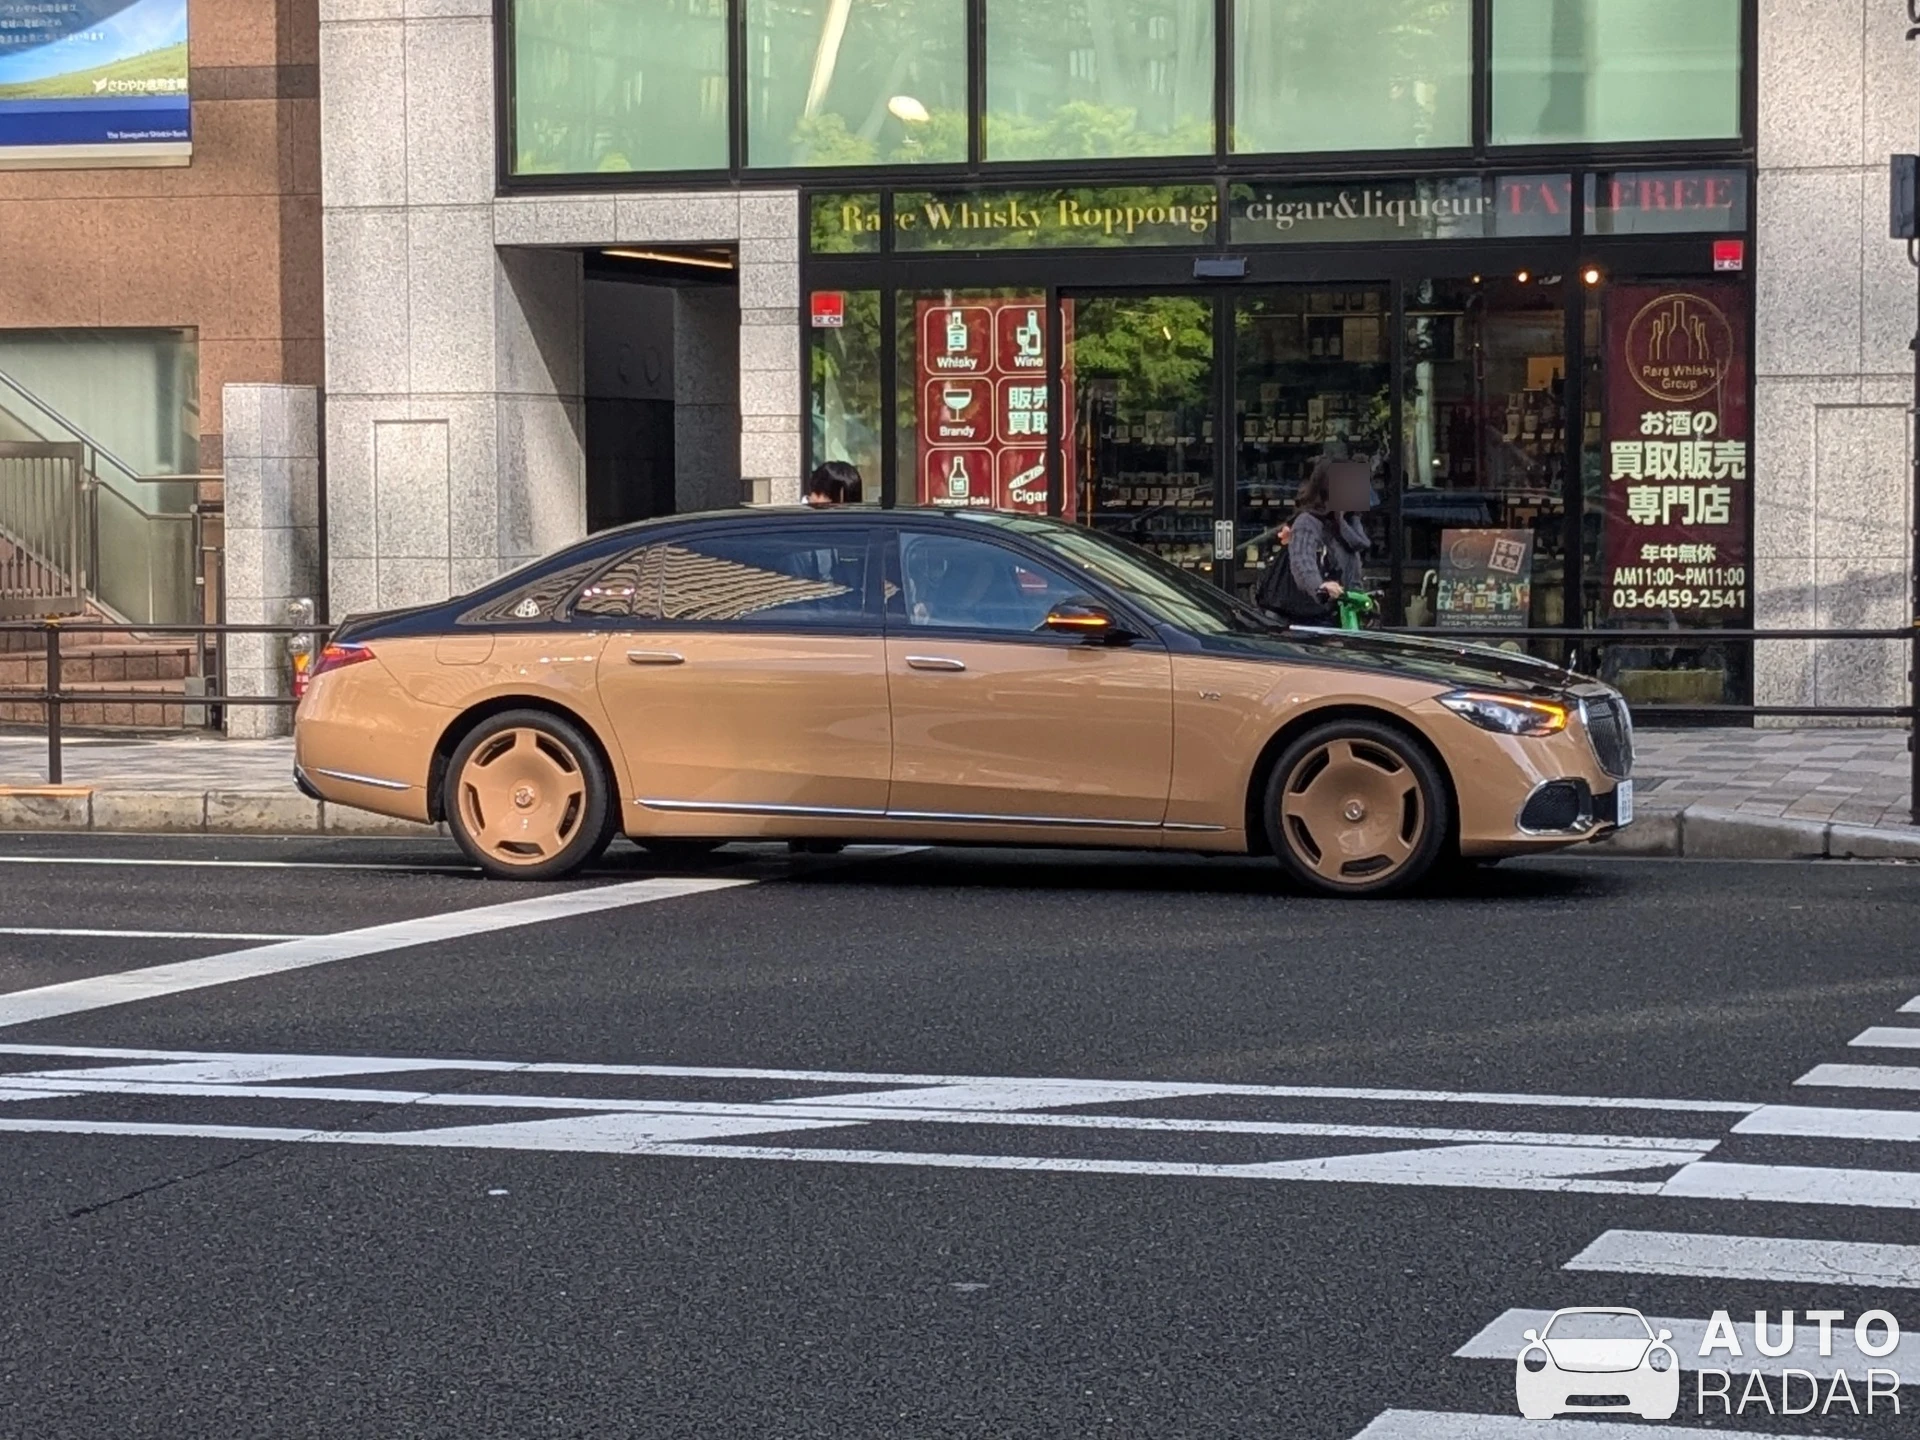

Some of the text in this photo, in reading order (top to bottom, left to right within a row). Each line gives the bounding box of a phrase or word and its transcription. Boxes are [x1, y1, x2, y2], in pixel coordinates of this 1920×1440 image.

[1502, 177, 1733, 216] TA FREE
[924, 200, 1046, 235] Whisky
[1059, 196, 1217, 235] Roppongi
[1246, 188, 1493, 231] cigar&liqueur
[937, 356, 978, 370] Whisky
[1014, 356, 1044, 367] Wine
[1643, 364, 1716, 378] Rare Whisky
[1662, 378, 1698, 391] Group
[939, 425, 976, 437] Brandy
[1640, 411, 1718, 436] お酒の
[1609, 440, 1747, 480] 買取販売
[1012, 489, 1048, 504] Cigar
[1627, 485, 1731, 526] 専門店
[1641, 544, 1717, 563] 年中無休
[1613, 589, 1745, 608] 03-6459-2541
